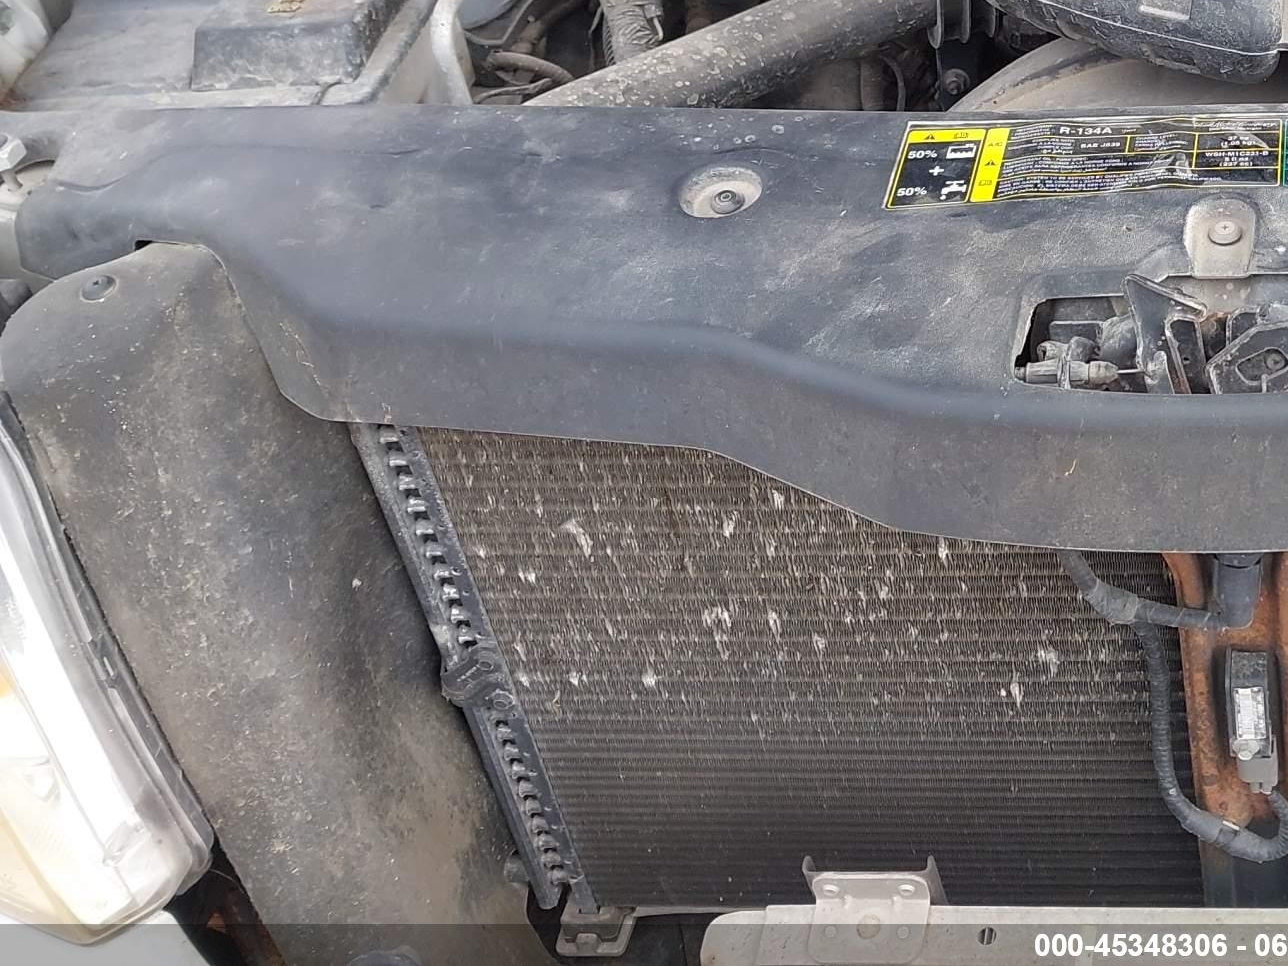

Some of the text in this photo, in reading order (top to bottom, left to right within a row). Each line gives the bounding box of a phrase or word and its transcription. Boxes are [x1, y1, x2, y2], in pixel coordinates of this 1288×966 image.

[1059, 126, 1112, 136] R-134A
[907, 149, 938, 159] 50%
[896, 186, 928, 197] 50%
